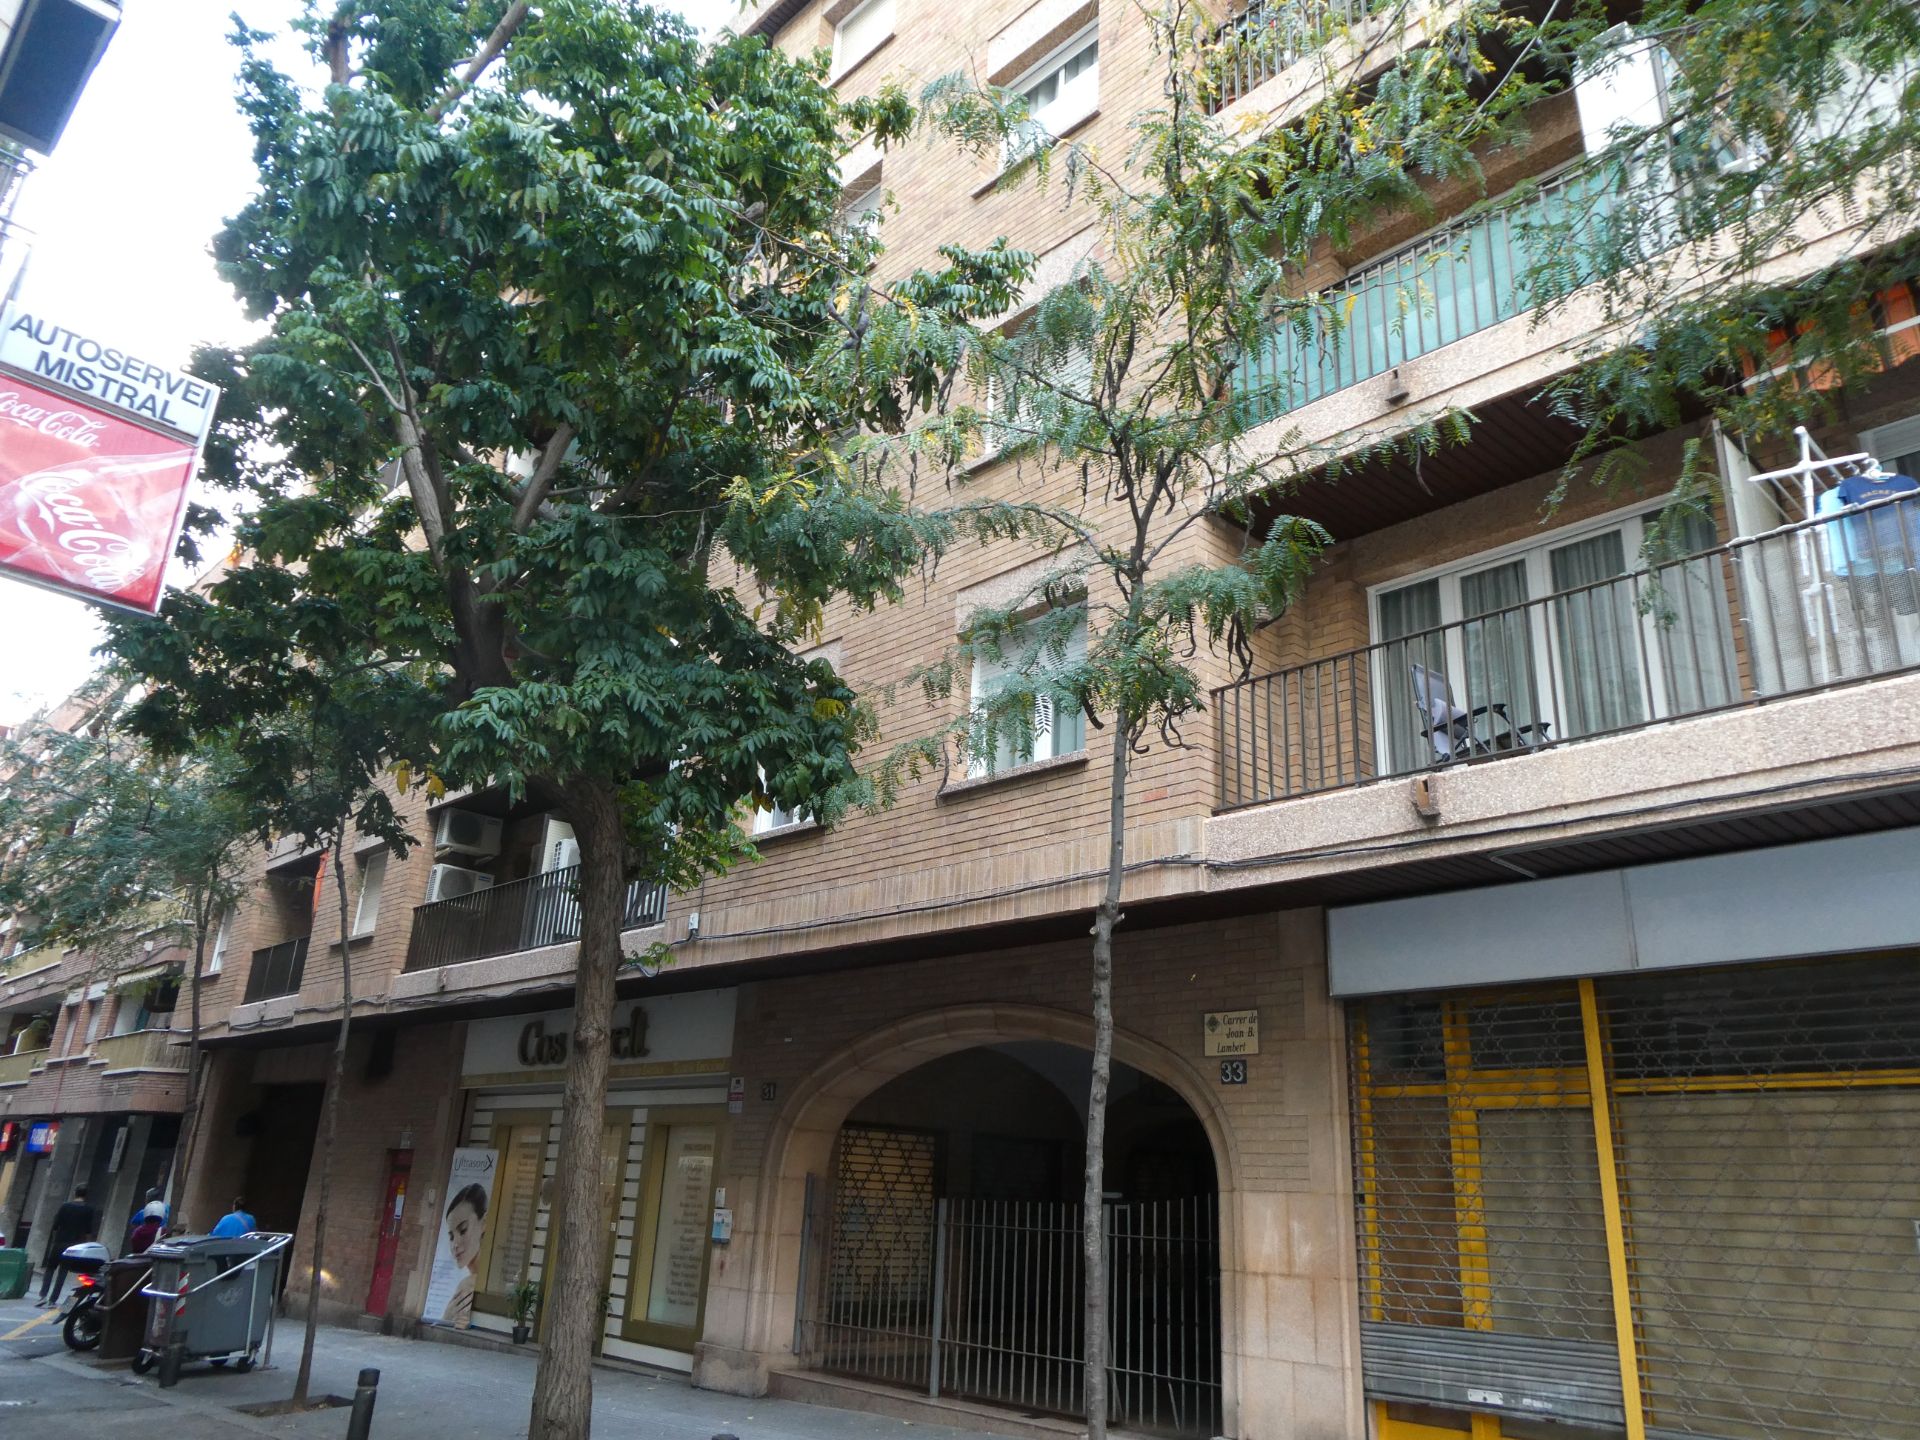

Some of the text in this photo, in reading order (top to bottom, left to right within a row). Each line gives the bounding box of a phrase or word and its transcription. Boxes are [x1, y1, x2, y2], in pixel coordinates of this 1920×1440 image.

[10, 313, 213, 409] AUTOSERVEI
[35, 350, 178, 426] MISTRAL
[0, 391, 107, 447] Coca-Cola
[1223, 1013, 1258, 1025] Carrer de
[1225, 1027, 1245, 1039] Joan
[1217, 1041, 1246, 1053] Lambert
[1221, 1061, 1244, 1083] 33
[762, 1083, 774, 1100] 31
